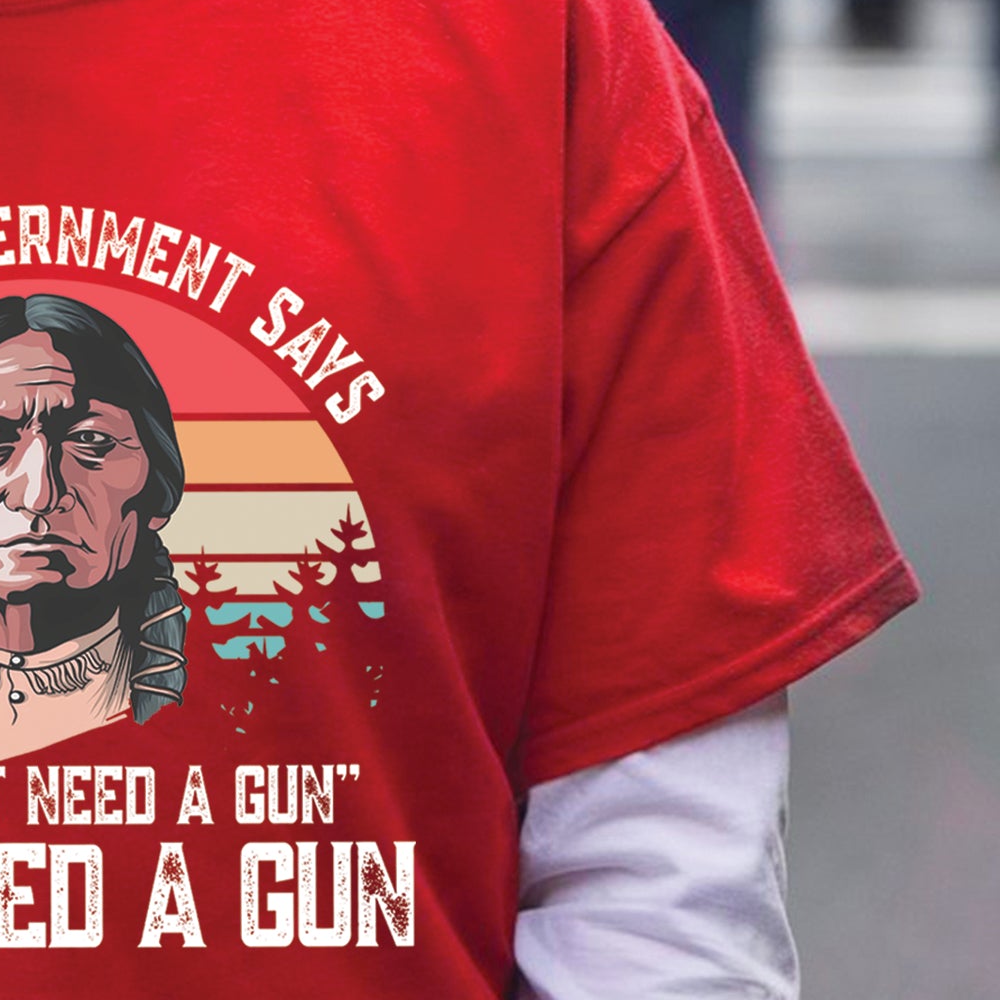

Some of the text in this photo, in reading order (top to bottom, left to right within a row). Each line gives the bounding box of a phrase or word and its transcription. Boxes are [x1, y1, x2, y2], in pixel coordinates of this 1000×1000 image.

[250, 287, 384, 423] SAYS
[27, 766, 155, 824] NEED
[177, 766, 213, 824] A
[138, 843, 206, 947] A
[241, 842, 416, 947] GUN
